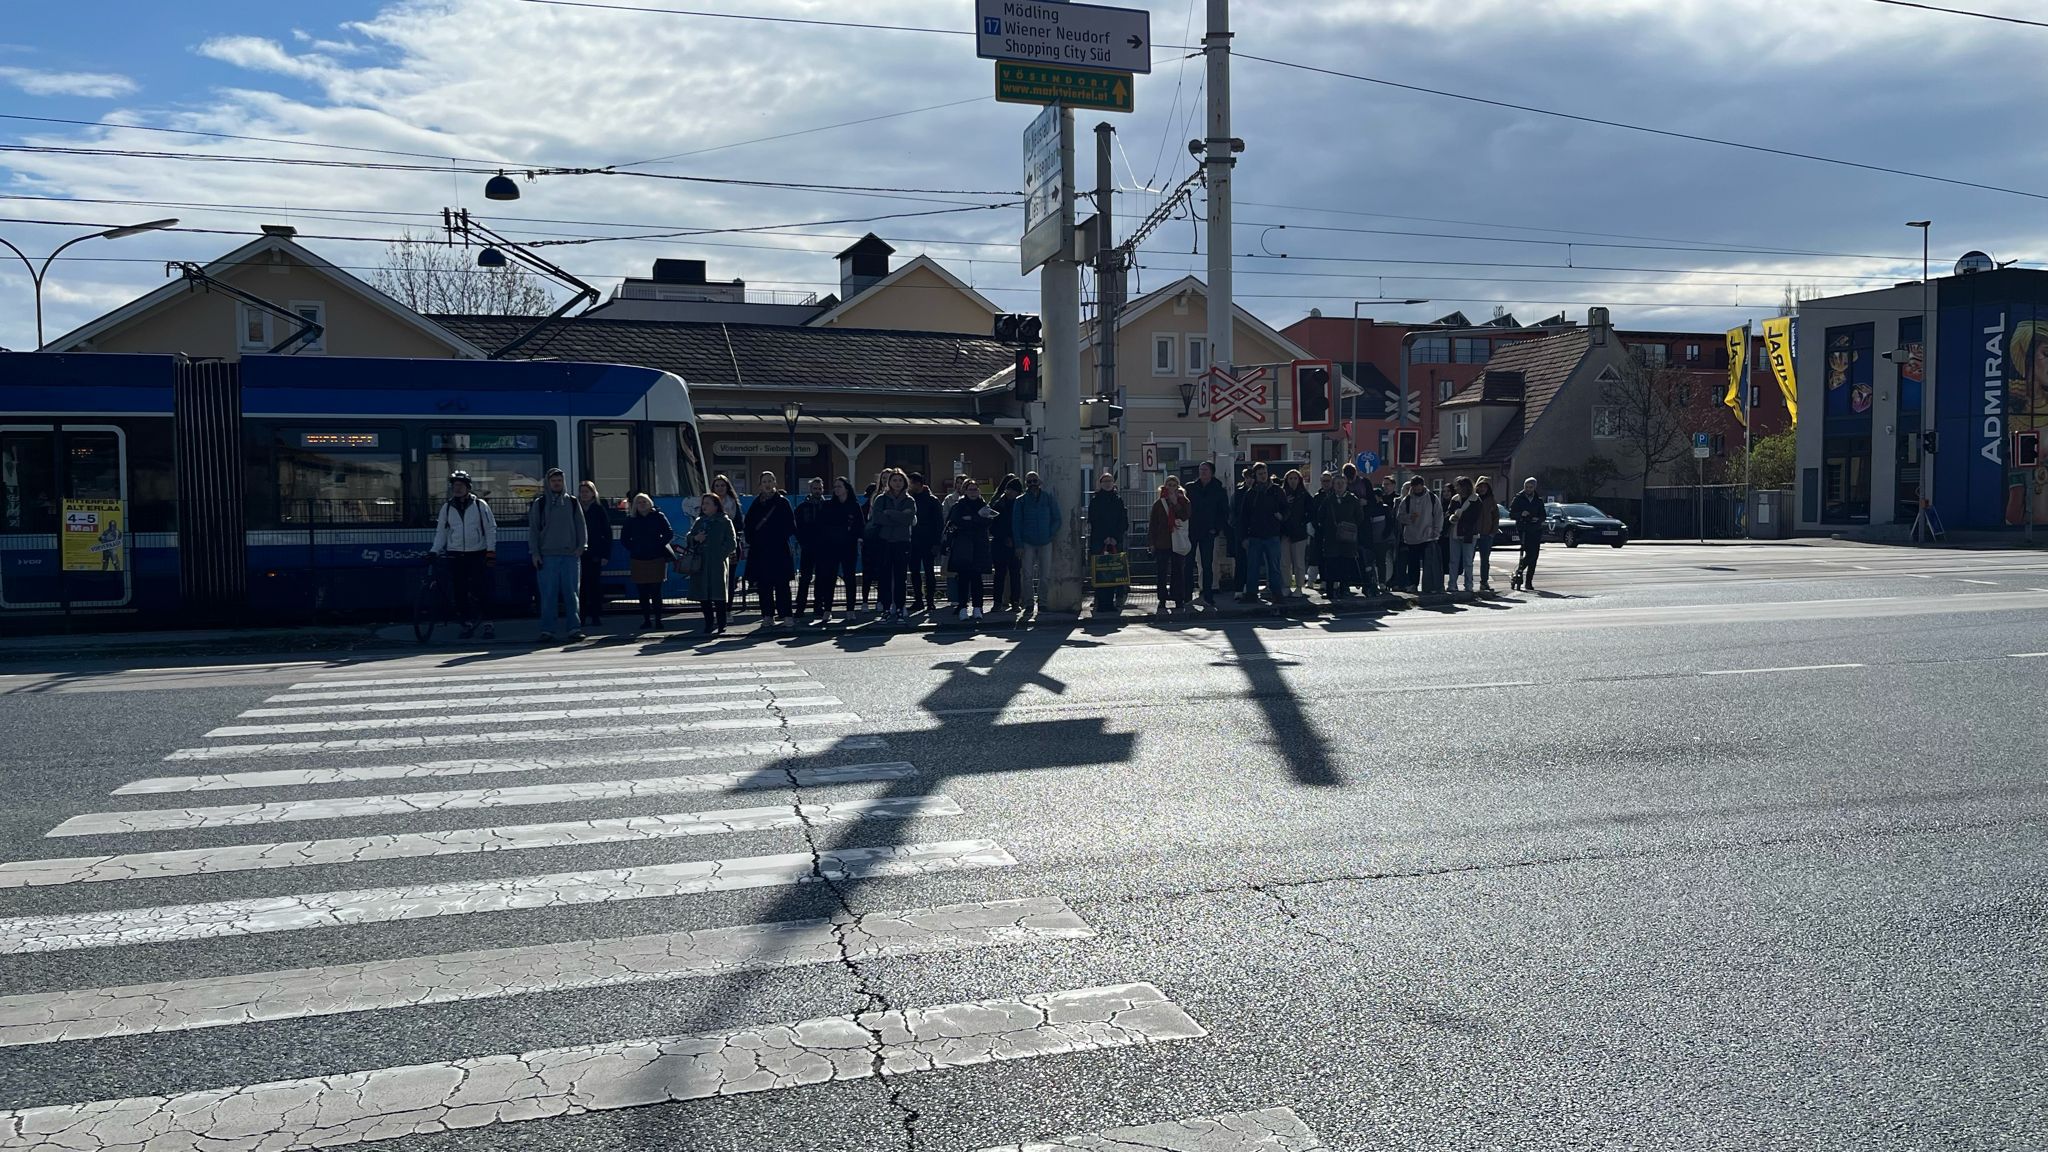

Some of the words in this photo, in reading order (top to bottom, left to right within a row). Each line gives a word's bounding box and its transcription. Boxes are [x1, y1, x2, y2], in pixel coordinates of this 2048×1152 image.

[1004, 2, 1059, 24] Mödling
[985, 19, 1000, 33] 17
[1005, 21, 1051, 39] Wiener
[1056, 27, 1111, 44] Neudorf
[1005, 38, 1060, 60] Shopping
[1064, 45, 1087, 62] City
[1090, 48, 1111, 62] Süd
[1003, 69, 1108, 89] VÖSENDORF
[1201, 381, 1207, 409] 6
[1981, 312, 2006, 465] ADMIRAL
[1699, 434, 1706, 443] P
[1146, 448, 1154, 468] 6
